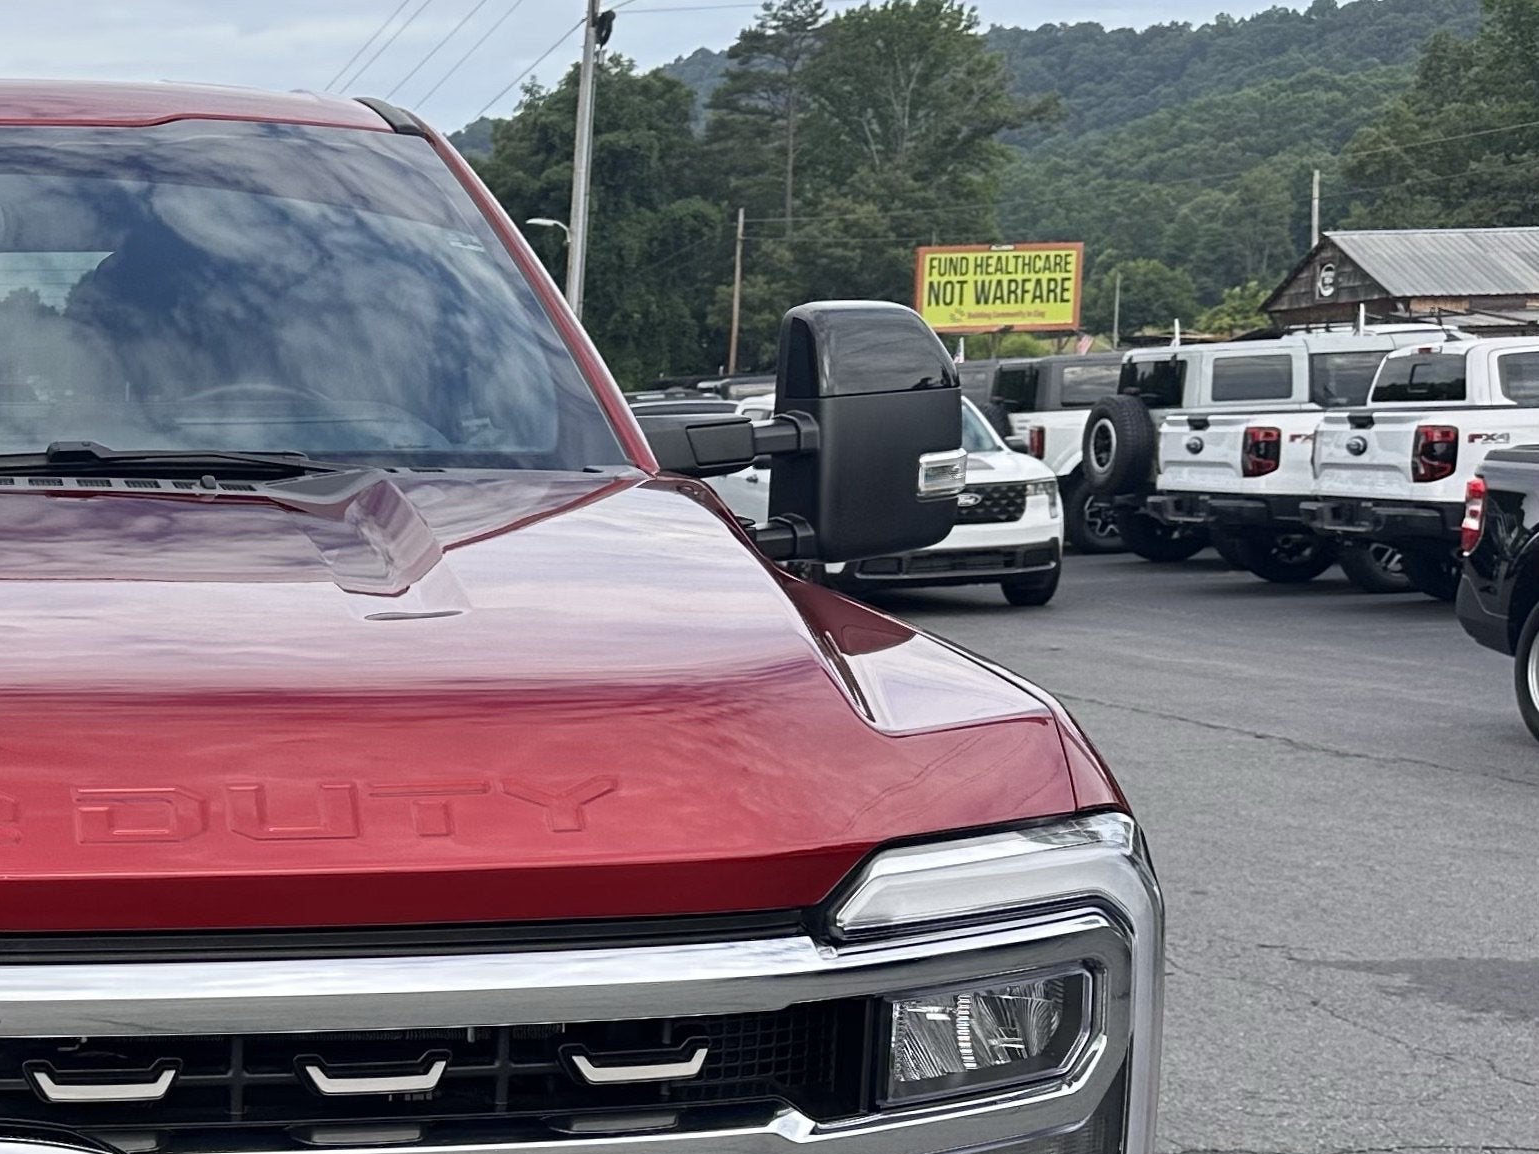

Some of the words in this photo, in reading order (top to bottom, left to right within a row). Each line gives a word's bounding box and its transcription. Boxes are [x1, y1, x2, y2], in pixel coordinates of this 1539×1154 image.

[928, 255, 969, 277] FUND
[973, 253, 1073, 276] HEALTHCARE
[927, 280, 968, 307] NOT
[973, 277, 1072, 305] WARFARE
[1288, 433, 1316, 443] FX
[1467, 432, 1510, 444] FX4
[71, 775, 618, 845] DUTY
